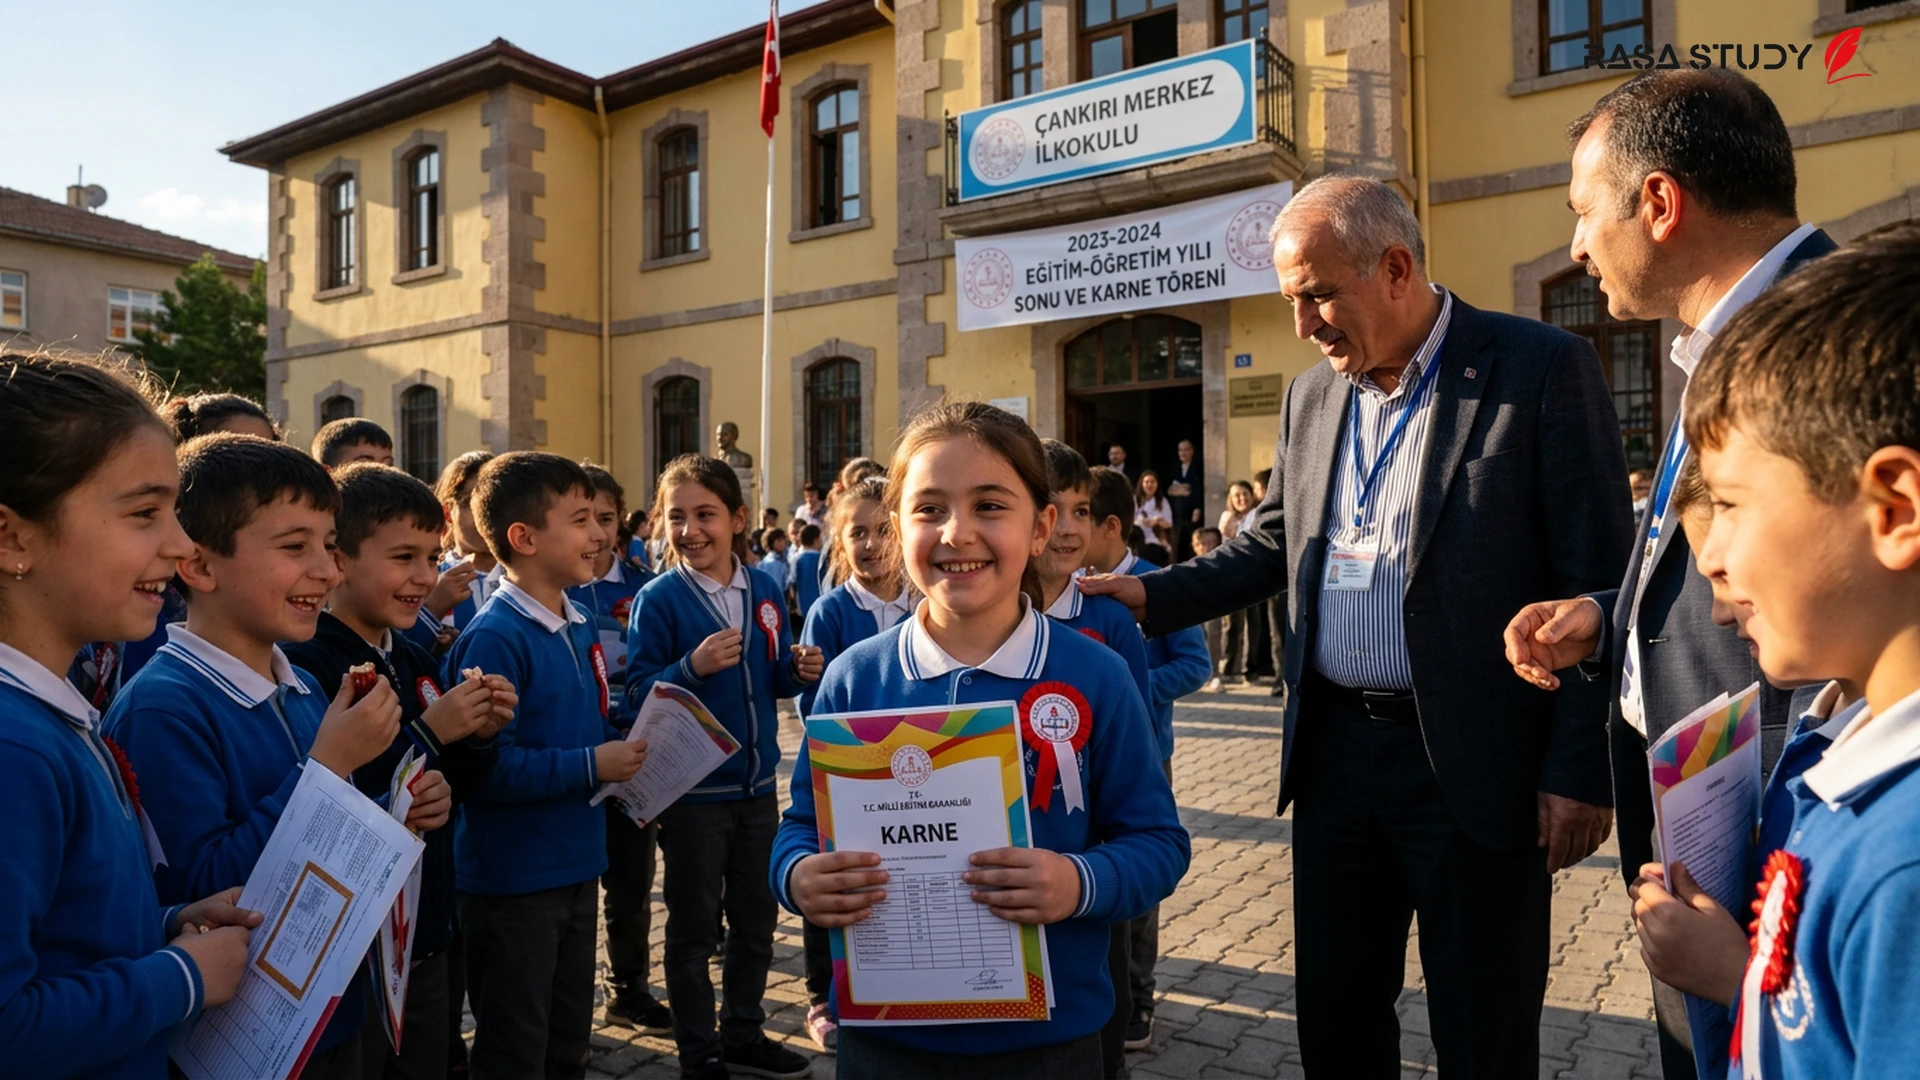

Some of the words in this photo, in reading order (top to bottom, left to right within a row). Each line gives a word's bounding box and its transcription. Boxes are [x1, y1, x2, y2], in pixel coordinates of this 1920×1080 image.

[1035, 97, 1118, 138] ÇANKIRI
[1124, 74, 1215, 114] MERKEZ
[1036, 124, 1139, 164] İLKOKULU
[1067, 221, 1162, 253] 2023-2024
[1025, 245, 1171, 285] EĞİTİM-ÖĞRETİM
[1176, 241, 1212, 264] YILI
[1014, 291, 1060, 313] SONU
[1064, 287, 1087, 307] VE
[1092, 278, 1152, 303] KARNE
[1156, 263, 1226, 295] TÖRENİ
[881, 822, 959, 845] KARNE
